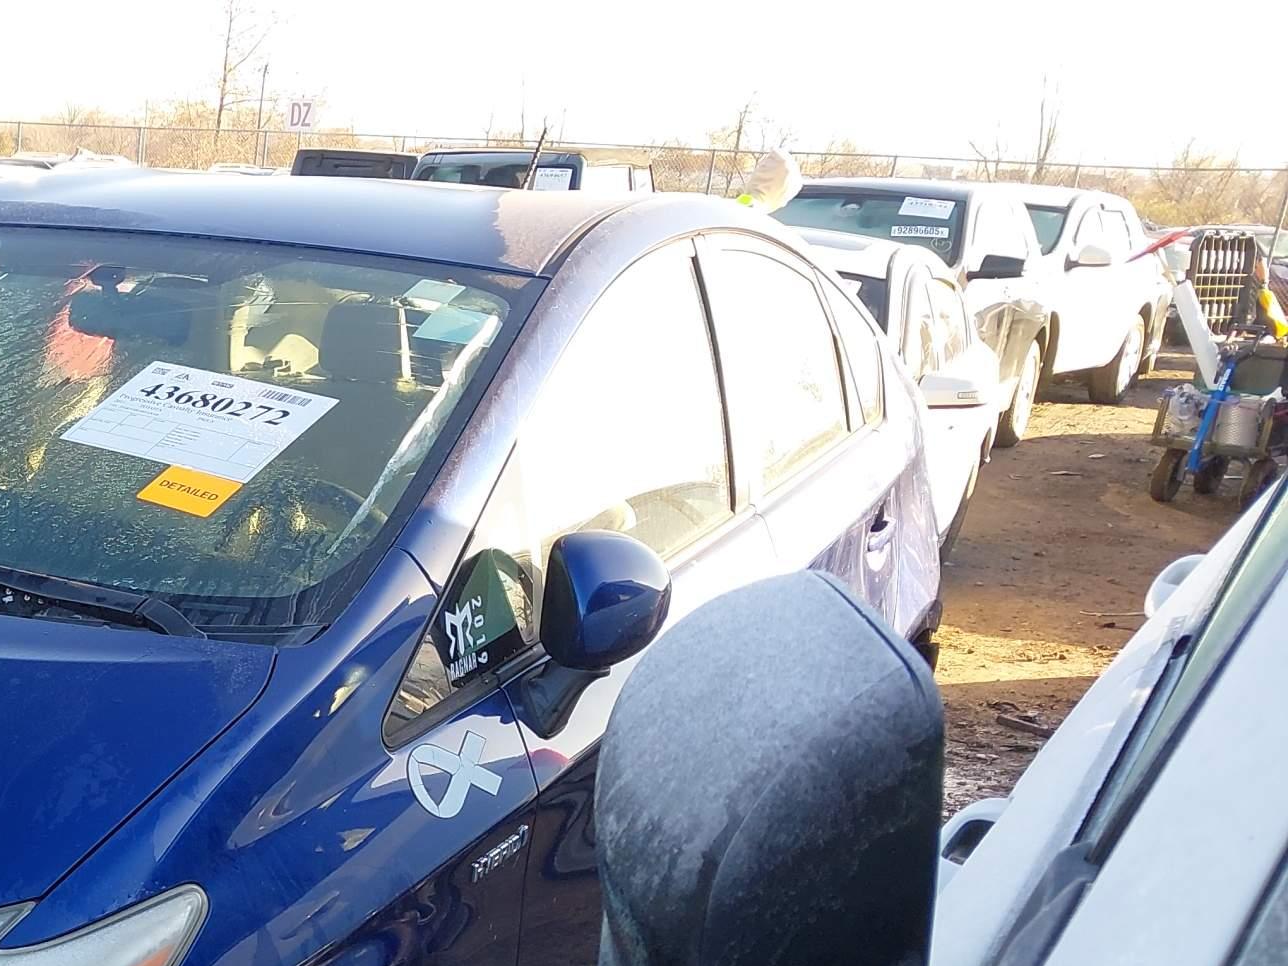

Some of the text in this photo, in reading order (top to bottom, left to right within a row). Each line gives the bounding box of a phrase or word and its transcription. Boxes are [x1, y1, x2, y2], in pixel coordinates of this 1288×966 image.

[290, 102, 312, 127] DZ
[140, 383, 290, 425] 43680272
[159, 479, 219, 501] DETAILED
[450, 652, 478, 681] RAGNAR
